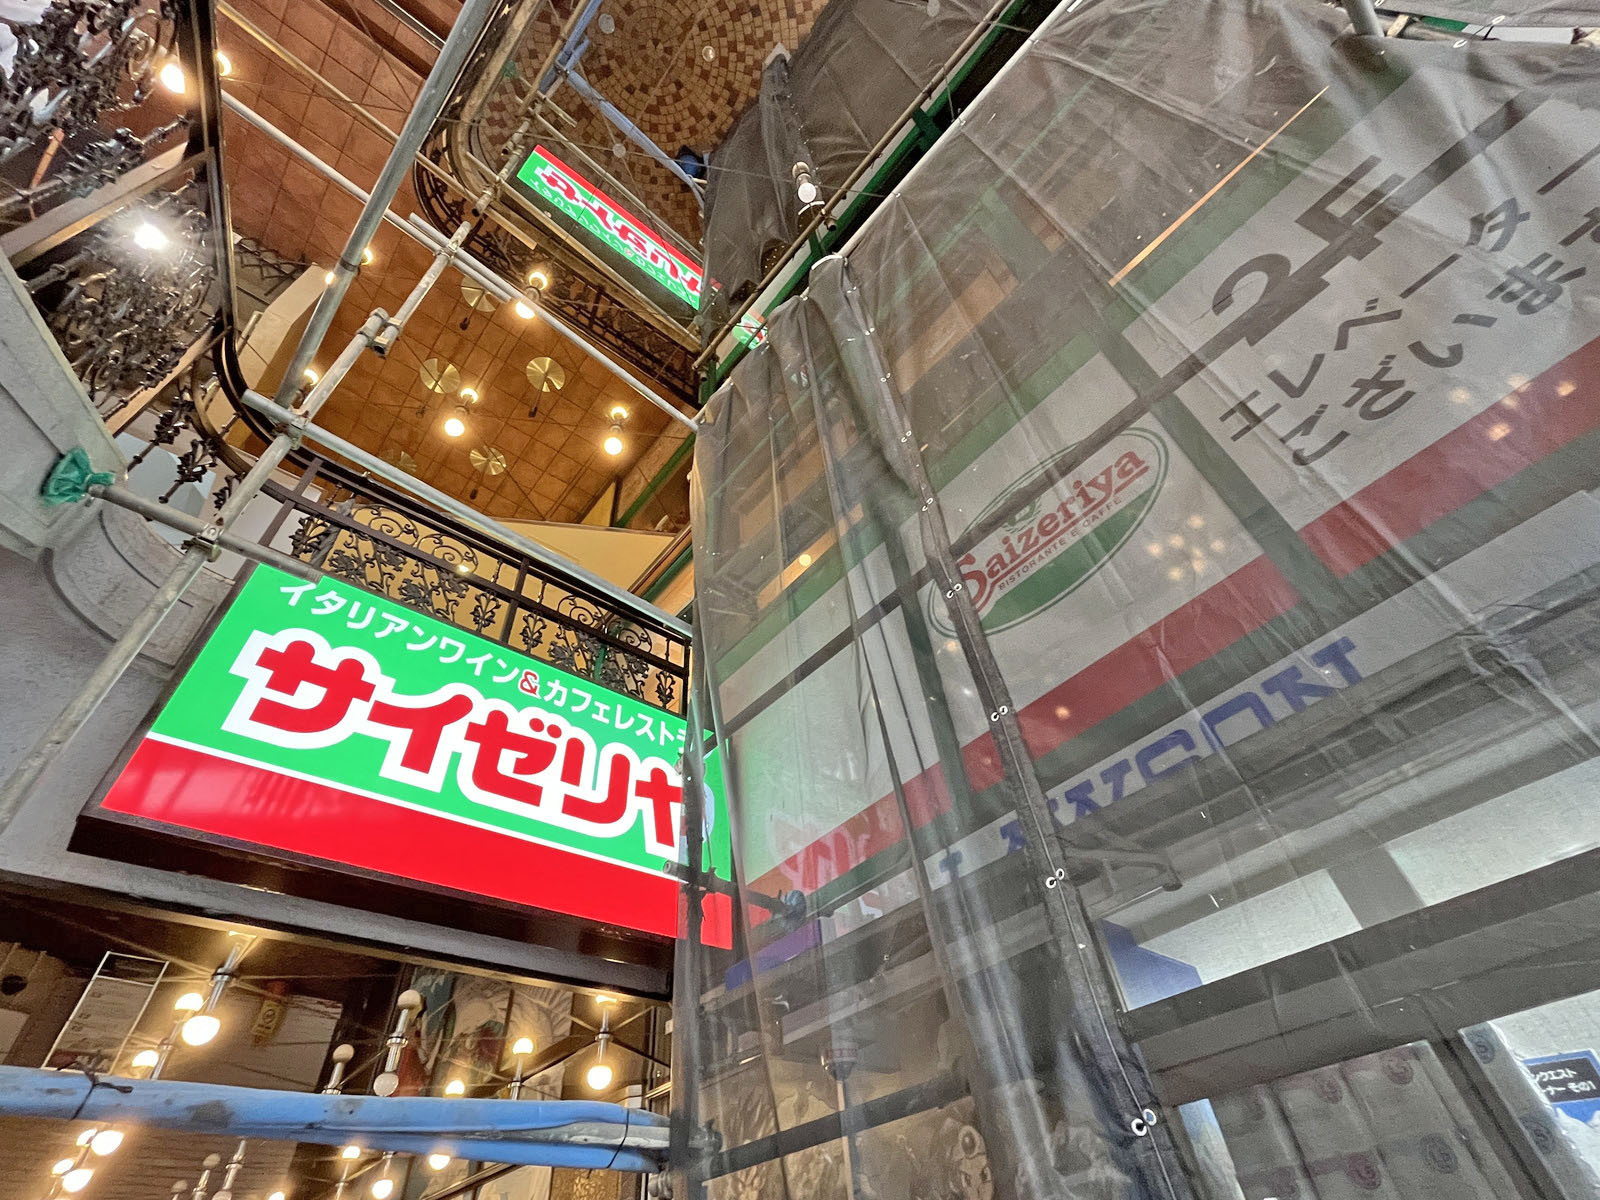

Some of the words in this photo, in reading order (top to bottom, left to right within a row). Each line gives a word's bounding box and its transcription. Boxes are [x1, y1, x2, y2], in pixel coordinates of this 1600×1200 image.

[1212, 155, 1406, 347] 2F
[956, 450, 1149, 609] Saizeriya
[998, 538, 1068, 590] RISTORANTE
[249, 640, 684, 850] サイゼリヤ
[939, 636, 1363, 882] LWSON
